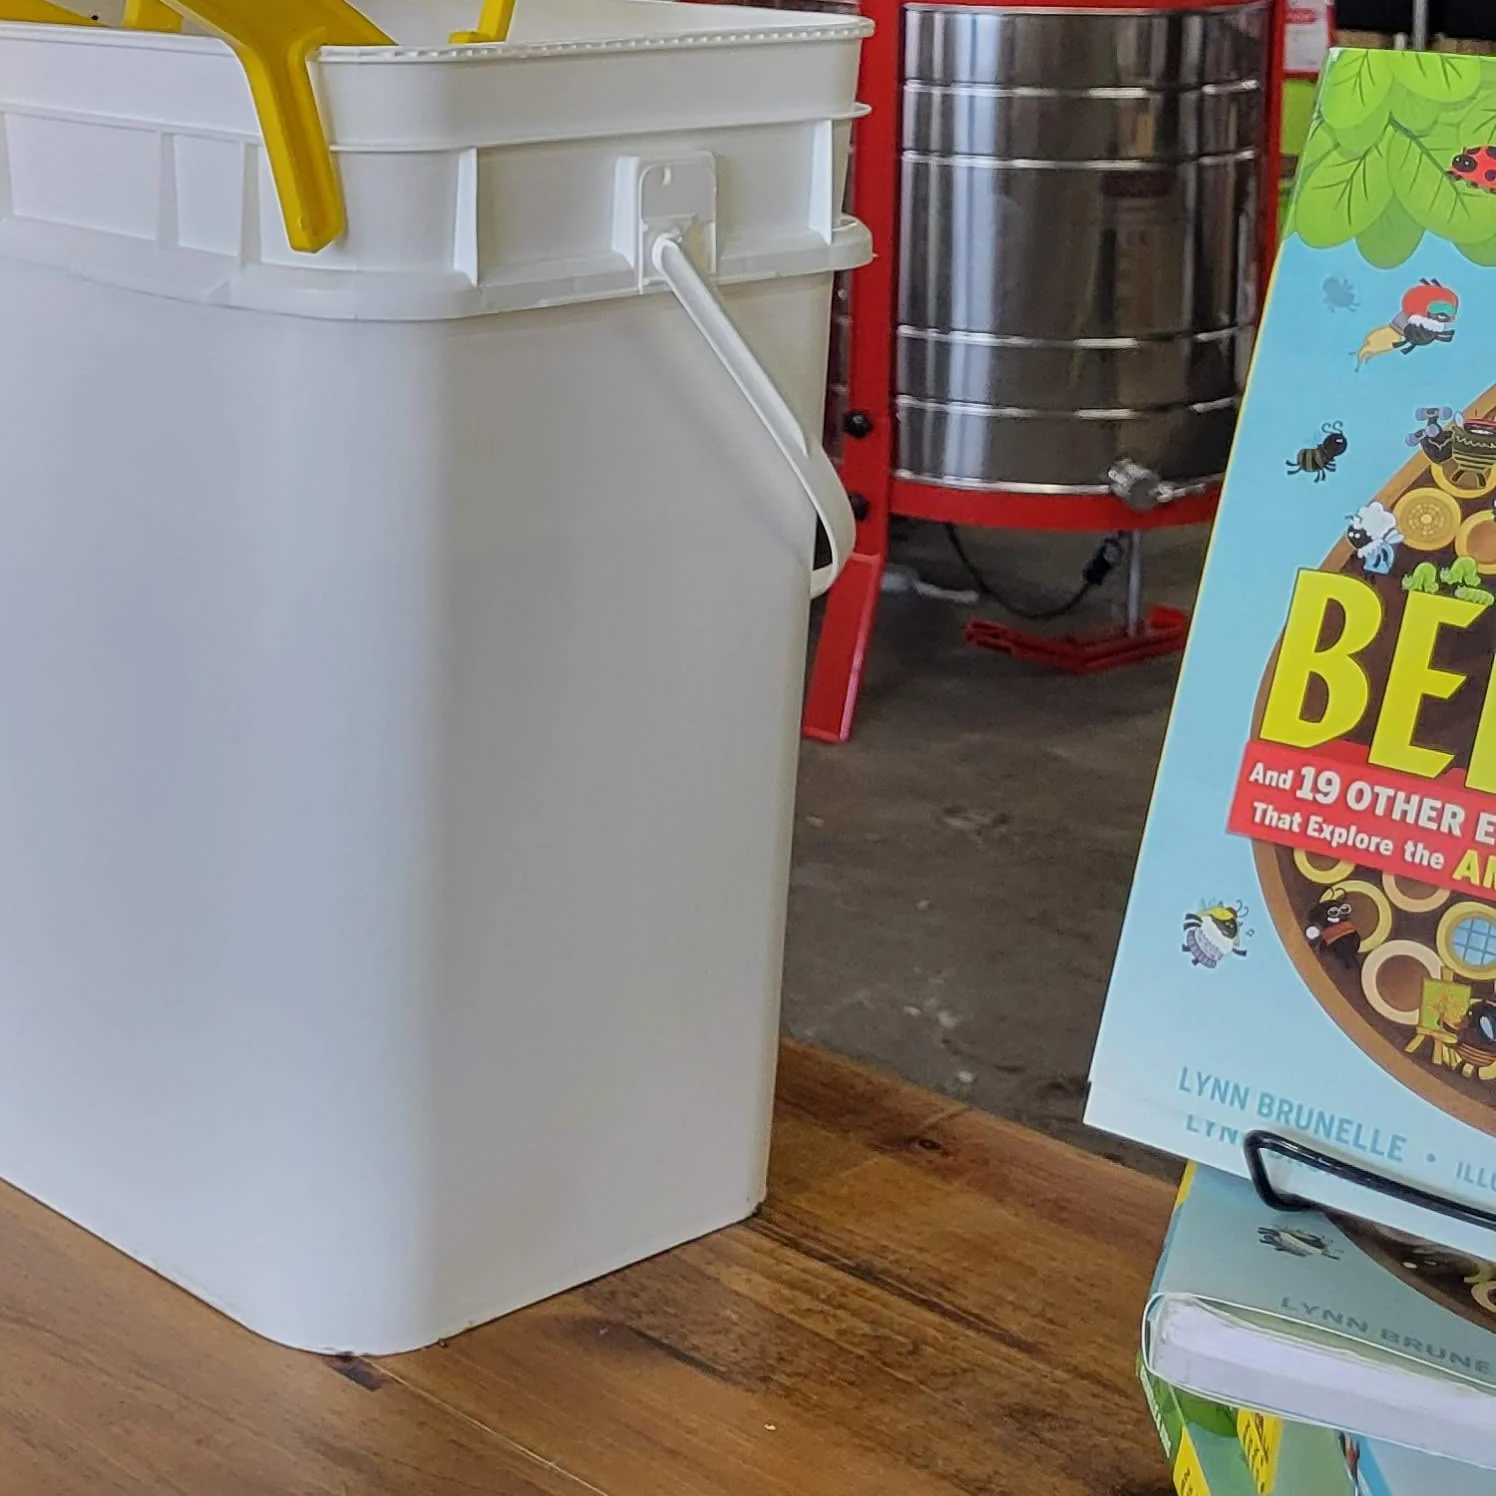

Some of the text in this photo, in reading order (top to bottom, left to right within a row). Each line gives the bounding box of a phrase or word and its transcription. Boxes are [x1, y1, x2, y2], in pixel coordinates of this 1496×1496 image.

[1249, 762, 1294, 791] And
[1295, 766, 1341, 805] 19
[1346, 780, 1466, 838] OTHER
[1253, 801, 1302, 833] That
[1306, 815, 1394, 857] Explore
[1404, 840, 1445, 871] the
[1178, 1066, 1251, 1112] LYNN
[1256, 1091, 1408, 1164] BRUNELLE
[1185, 1113, 1249, 1146] LYN
[1280, 1296, 1369, 1334] LYNN
